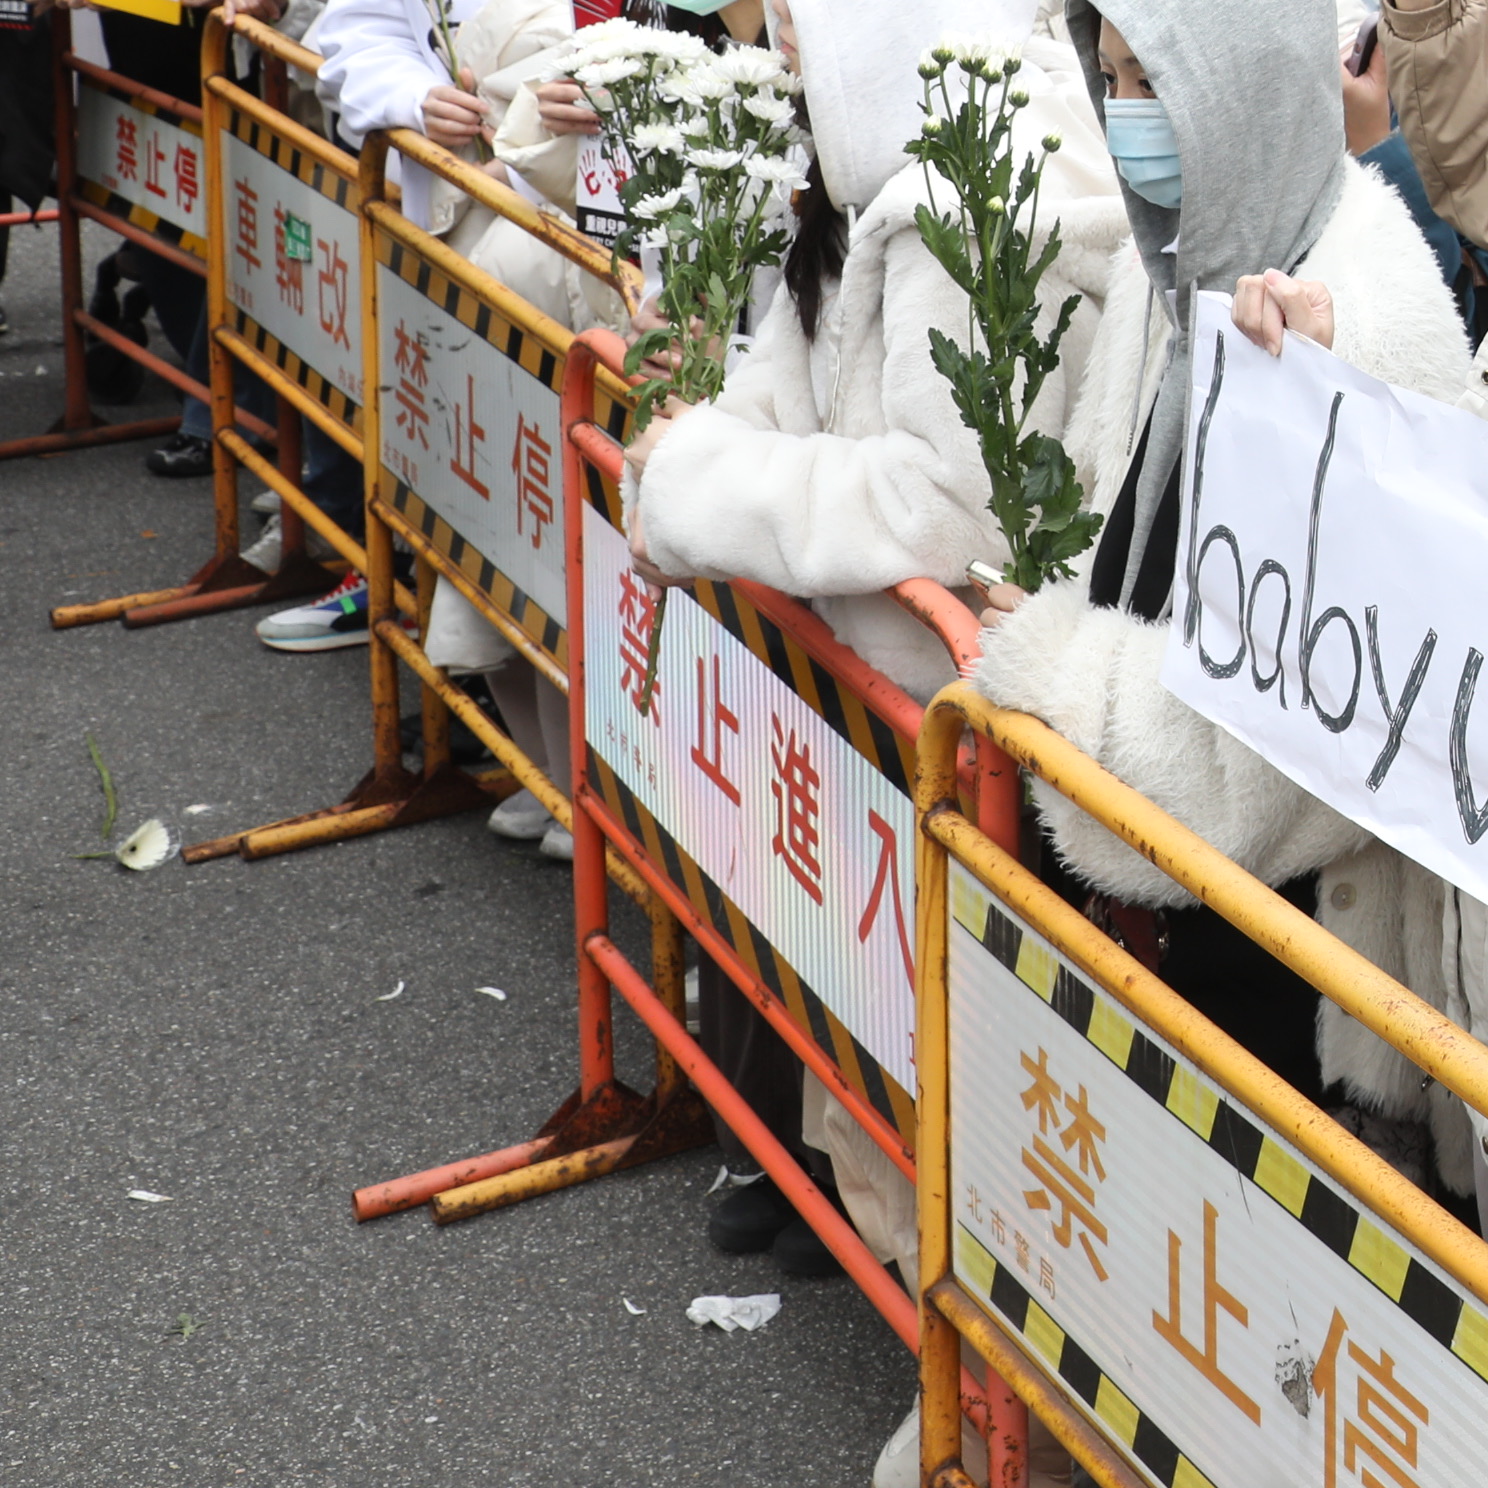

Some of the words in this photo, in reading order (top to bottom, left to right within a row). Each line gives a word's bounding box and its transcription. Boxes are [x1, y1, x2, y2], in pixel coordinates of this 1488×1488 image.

[116, 114, 198, 213] 禁止停
[394, 318, 554, 549] 禁止停
[1182, 328, 1439, 792] baby
[618, 567, 915, 996] 禁止進入
[964, 1184, 1058, 1301] 北市警局
